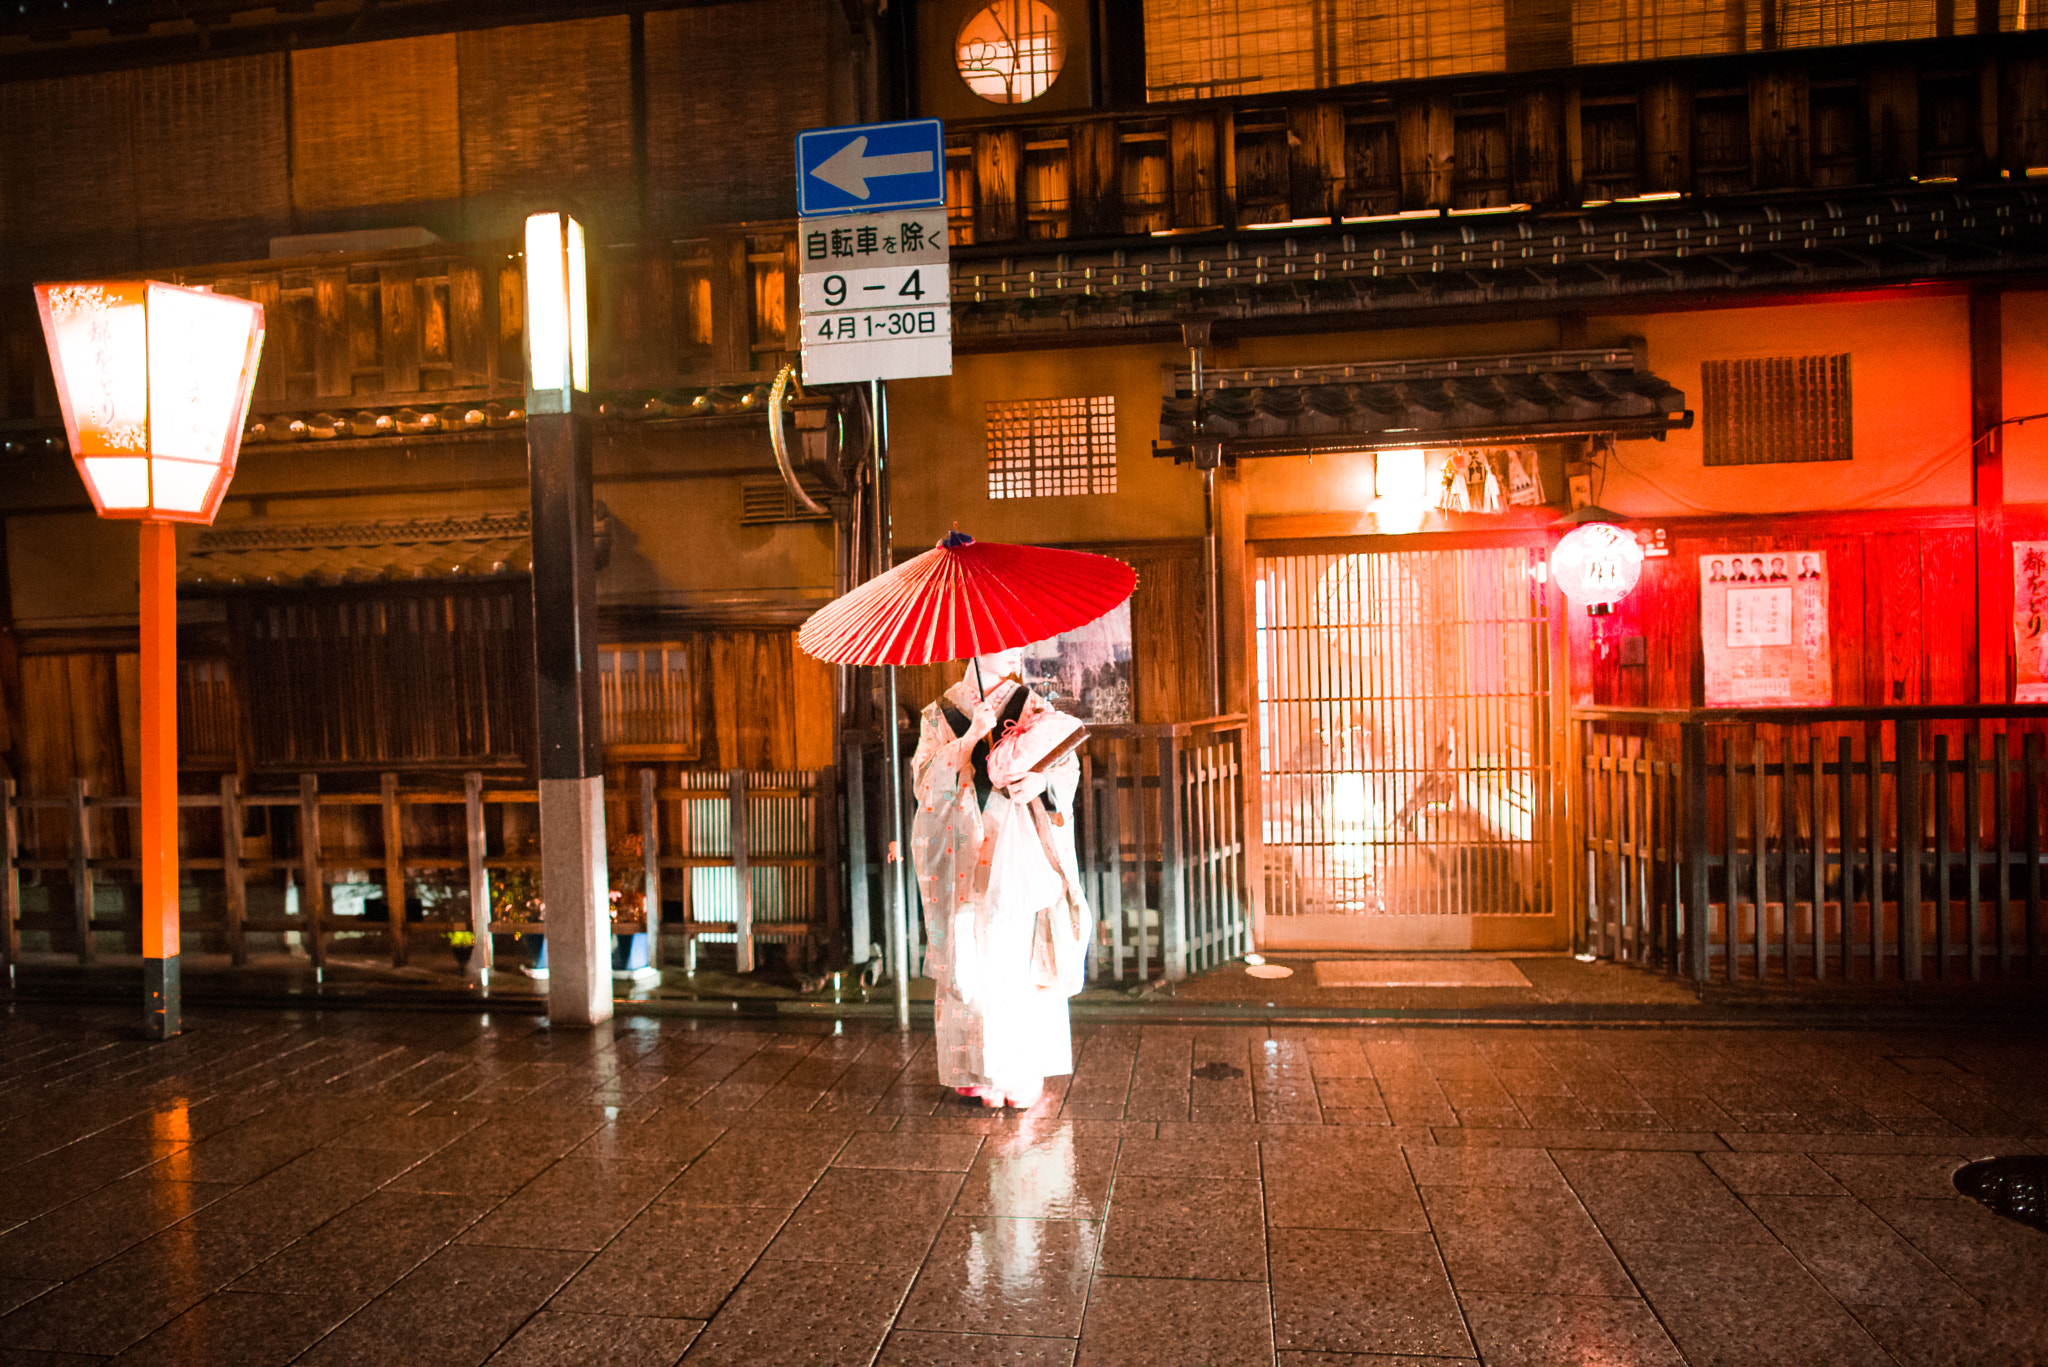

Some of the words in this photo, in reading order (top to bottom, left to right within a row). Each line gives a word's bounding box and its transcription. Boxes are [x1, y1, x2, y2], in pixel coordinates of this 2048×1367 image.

[807, 221, 941, 260] 自転車を除く
